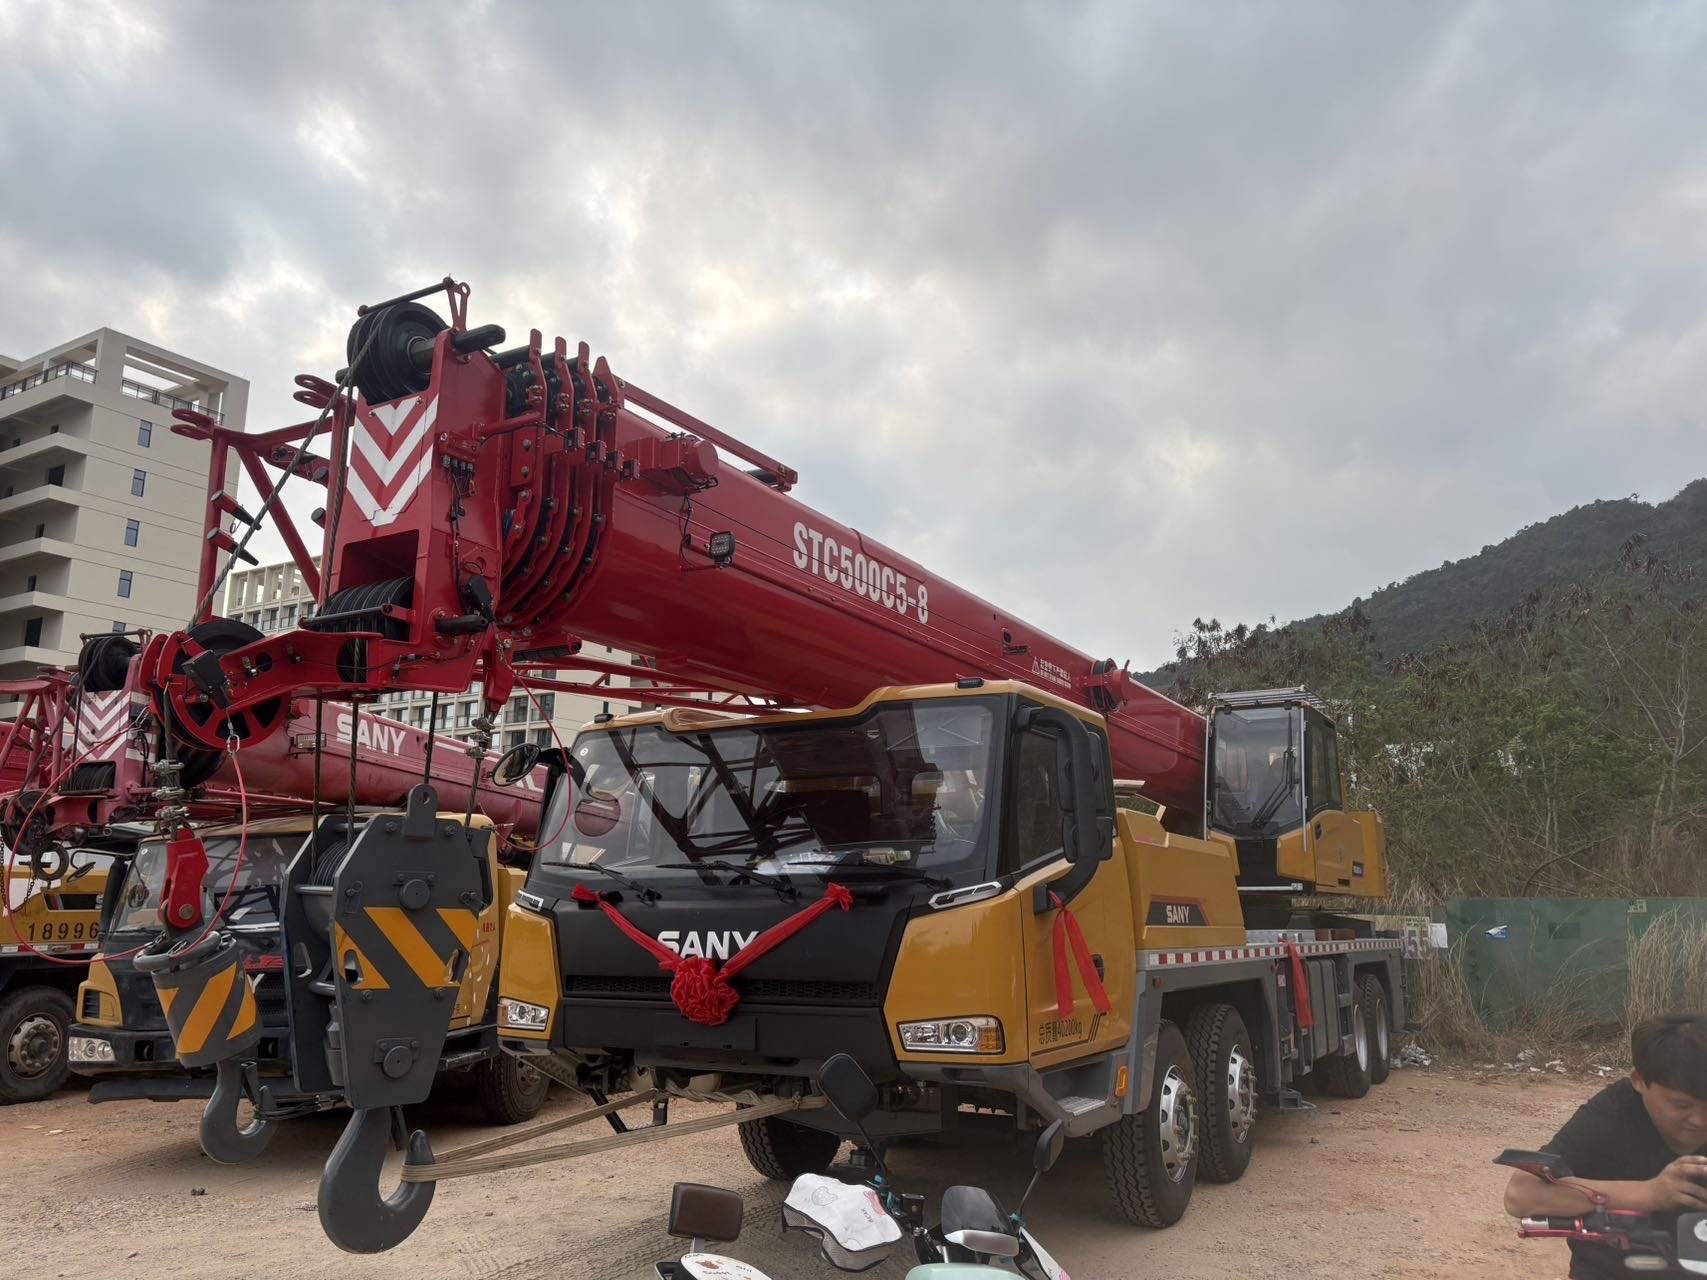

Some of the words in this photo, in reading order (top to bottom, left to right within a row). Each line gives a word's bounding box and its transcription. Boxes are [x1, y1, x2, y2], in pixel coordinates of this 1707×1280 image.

[793, 521, 929, 624] STC500C5-8
[336, 713, 406, 756] SANY
[1166, 904, 1189, 924] SANY
[28, 921, 99, 941] 18996
[657, 930, 759, 960] SANY
